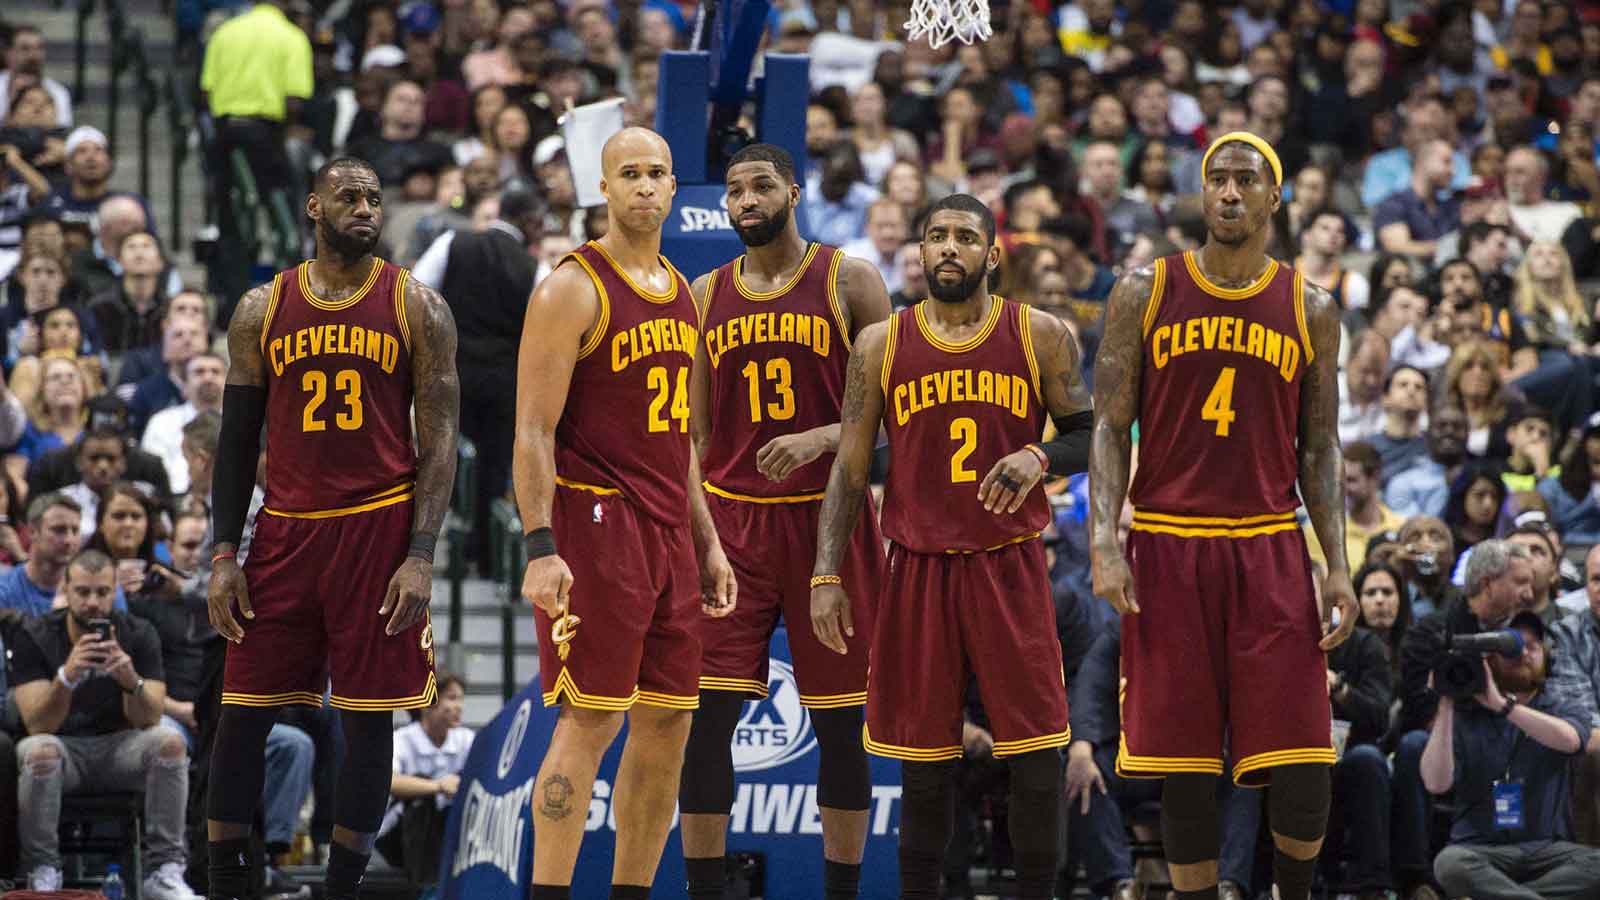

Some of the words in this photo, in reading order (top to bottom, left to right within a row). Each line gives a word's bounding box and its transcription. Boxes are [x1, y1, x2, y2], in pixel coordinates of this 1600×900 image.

[680, 206, 735, 232] SPAL
[269, 324, 399, 377] CLEVELAND
[611, 319, 698, 372] CLEVELAN
[705, 312, 830, 369] CLEVELAND
[1152, 316, 1300, 383] CLEVELAND
[302, 369, 363, 432] 23
[647, 366, 690, 433] 24
[742, 357, 796, 423] 13
[894, 369, 1029, 426] CLEVELAND
[1201, 367, 1236, 437] 4
[950, 417, 977, 483] 2
[736, 728, 788, 746] RTS
